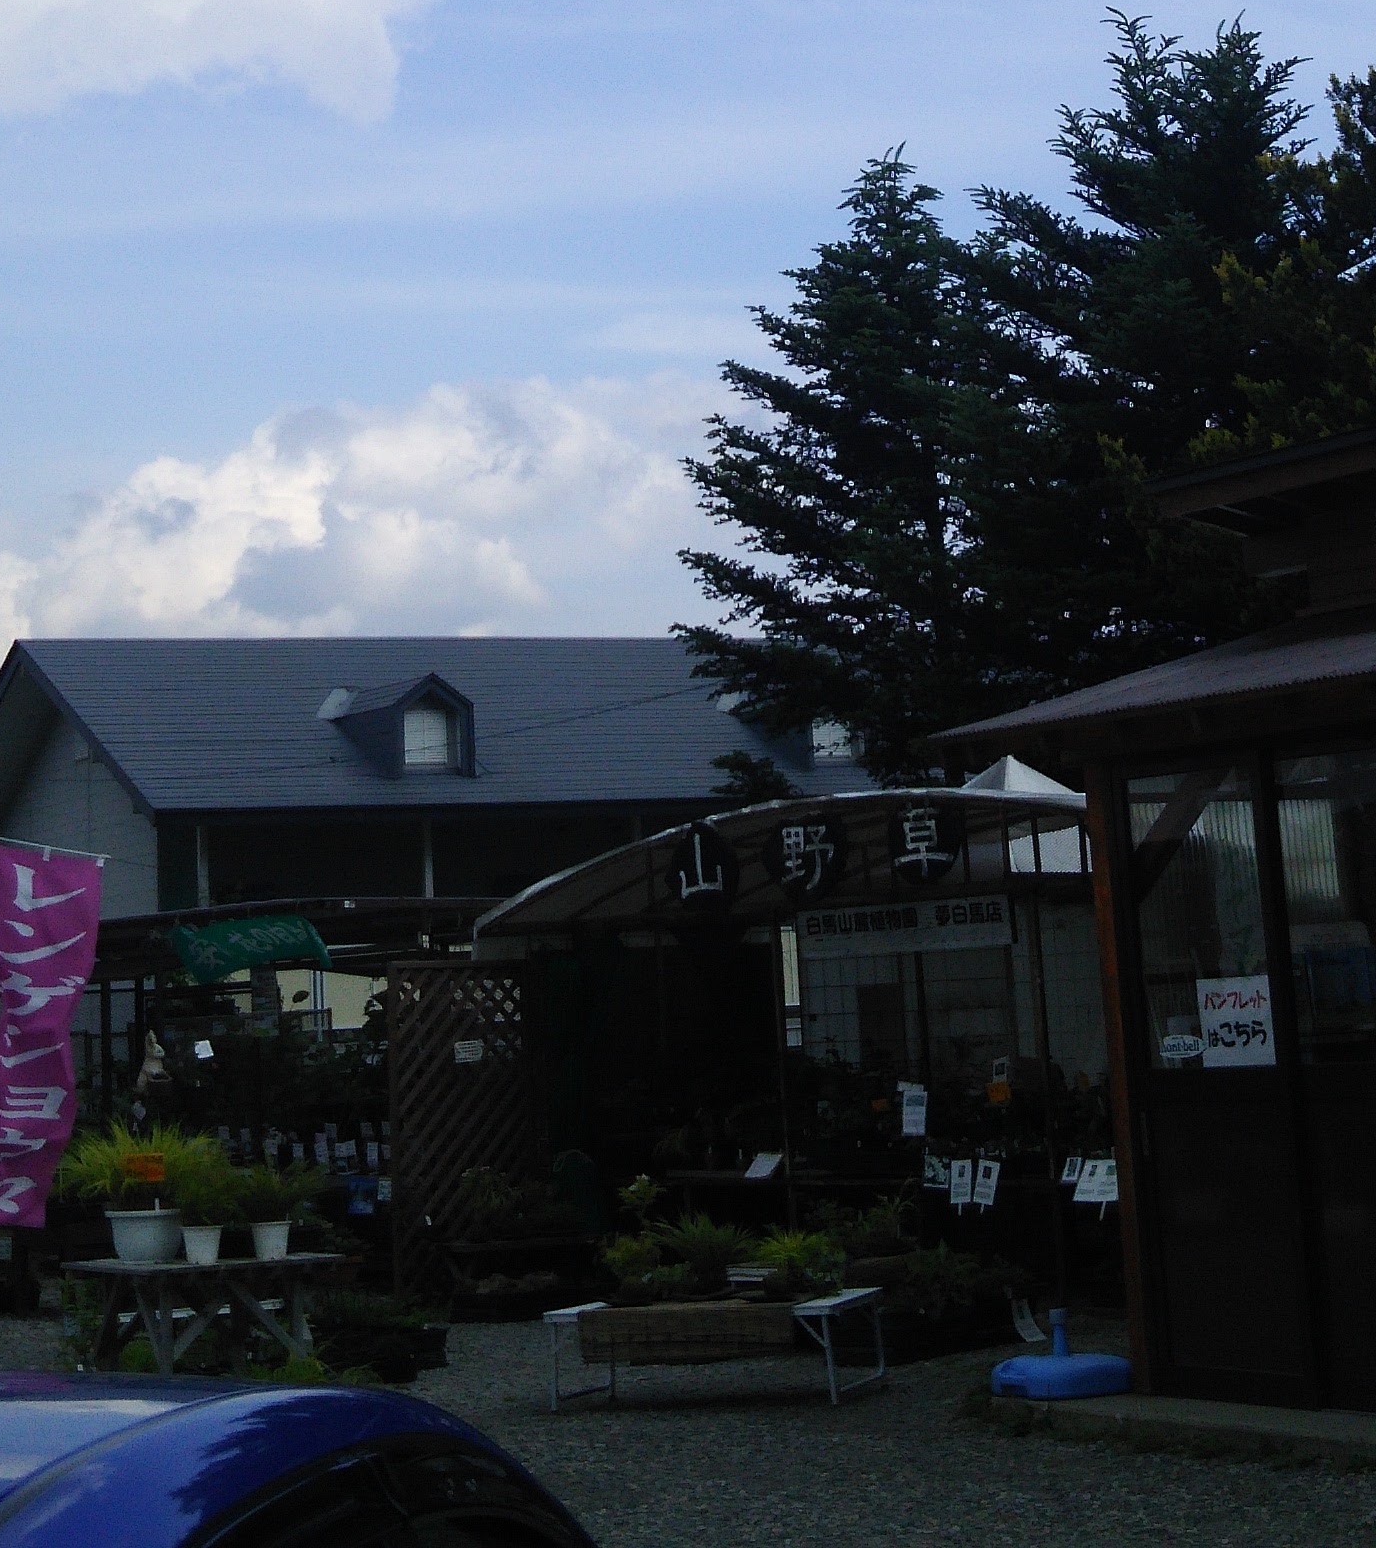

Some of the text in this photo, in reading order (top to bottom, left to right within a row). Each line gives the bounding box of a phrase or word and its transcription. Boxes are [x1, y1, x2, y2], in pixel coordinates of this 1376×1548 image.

[678, 802, 955, 900] 山野草
[1204, 989, 1268, 1010] パンフレット
[1207, 1019, 1268, 1048] はこちら
